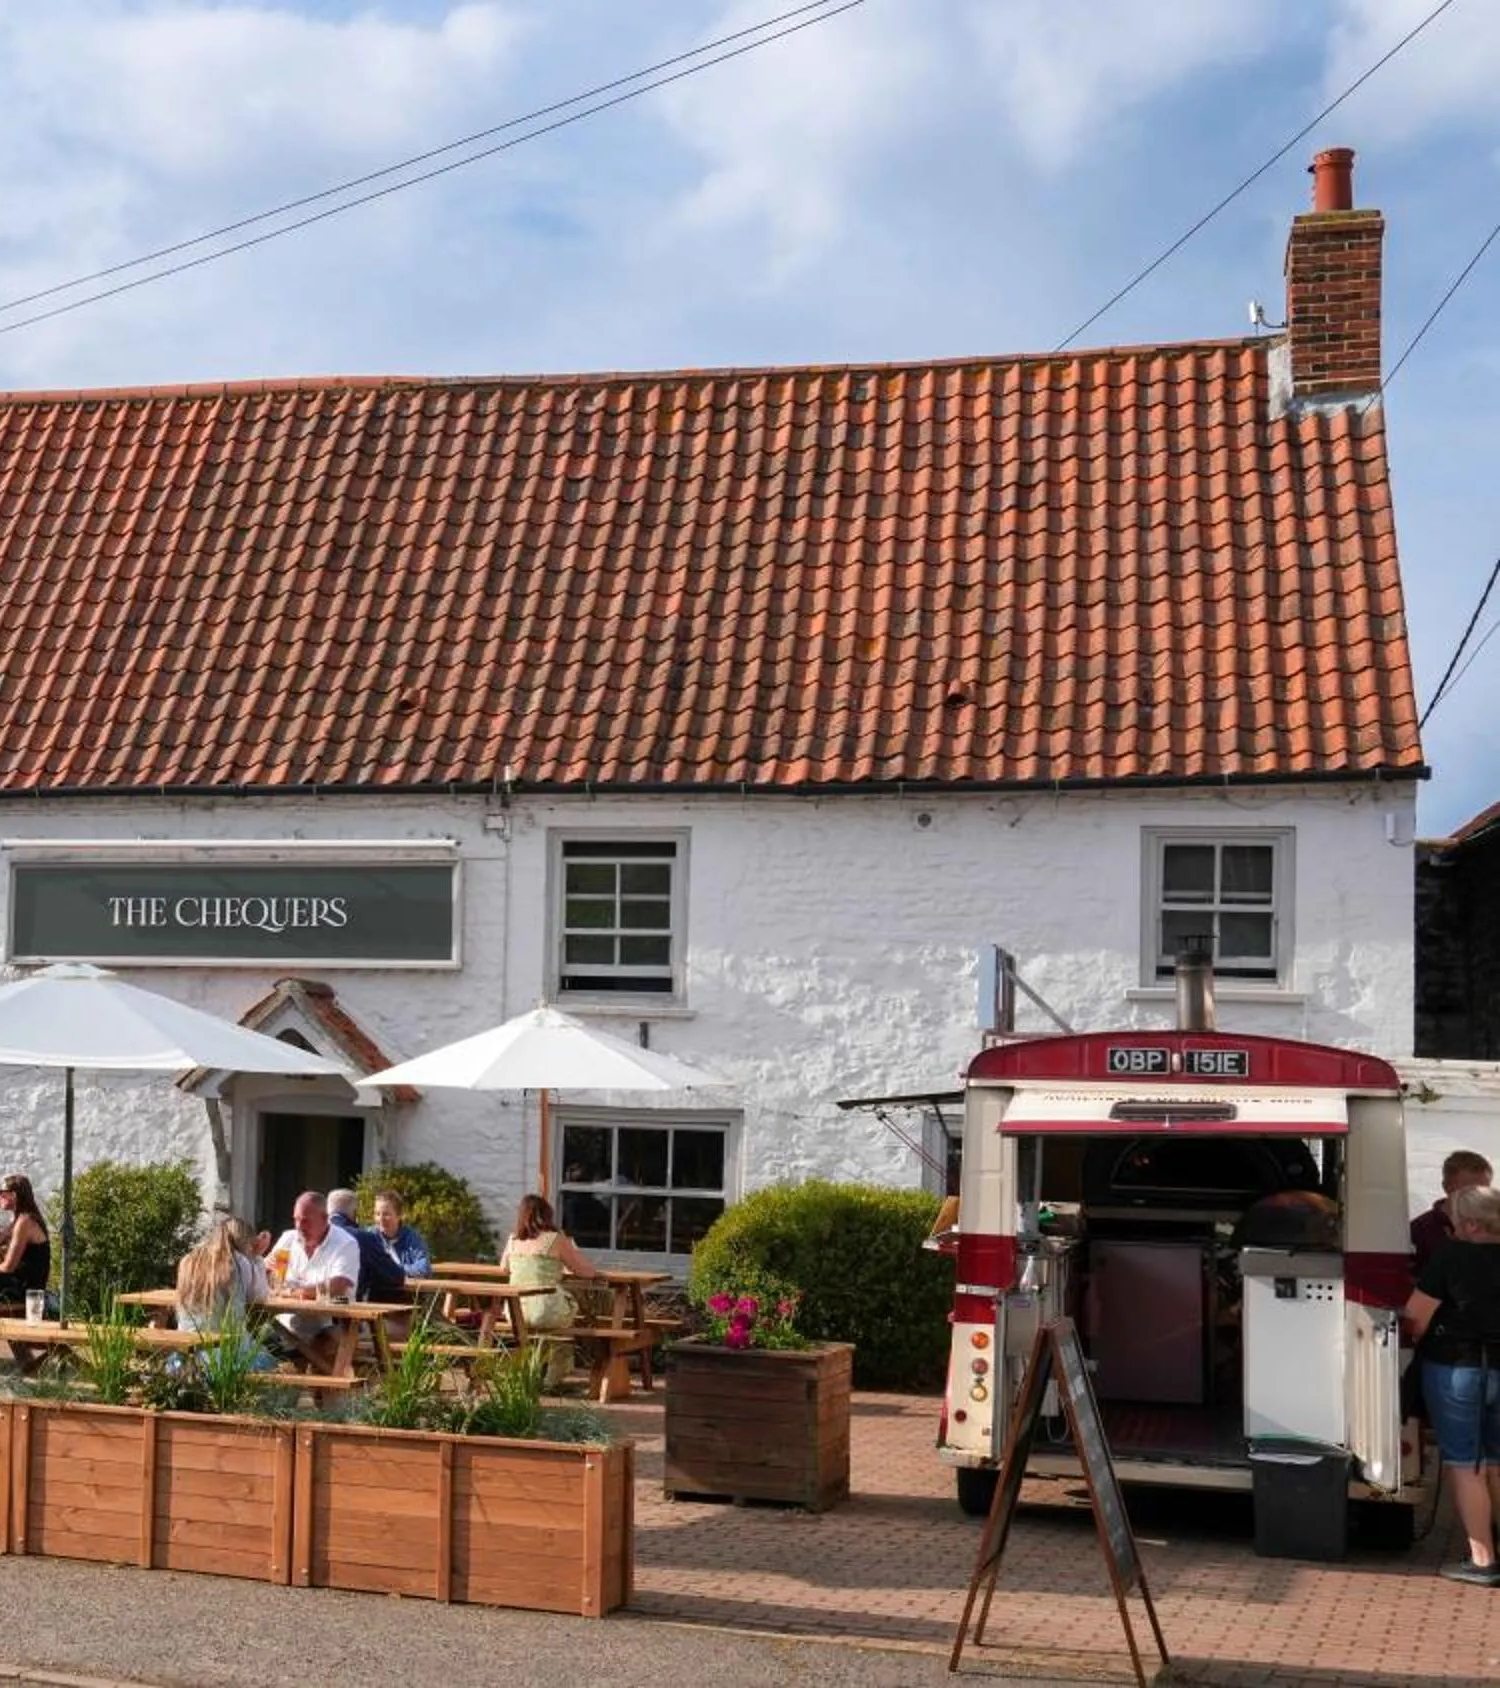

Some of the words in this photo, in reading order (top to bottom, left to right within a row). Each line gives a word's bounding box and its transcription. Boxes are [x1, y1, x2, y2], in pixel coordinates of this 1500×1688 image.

[109, 897, 167, 927] THE
[174, 896, 348, 933] CHEQUERS
[1113, 1051, 1163, 1072] OBP
